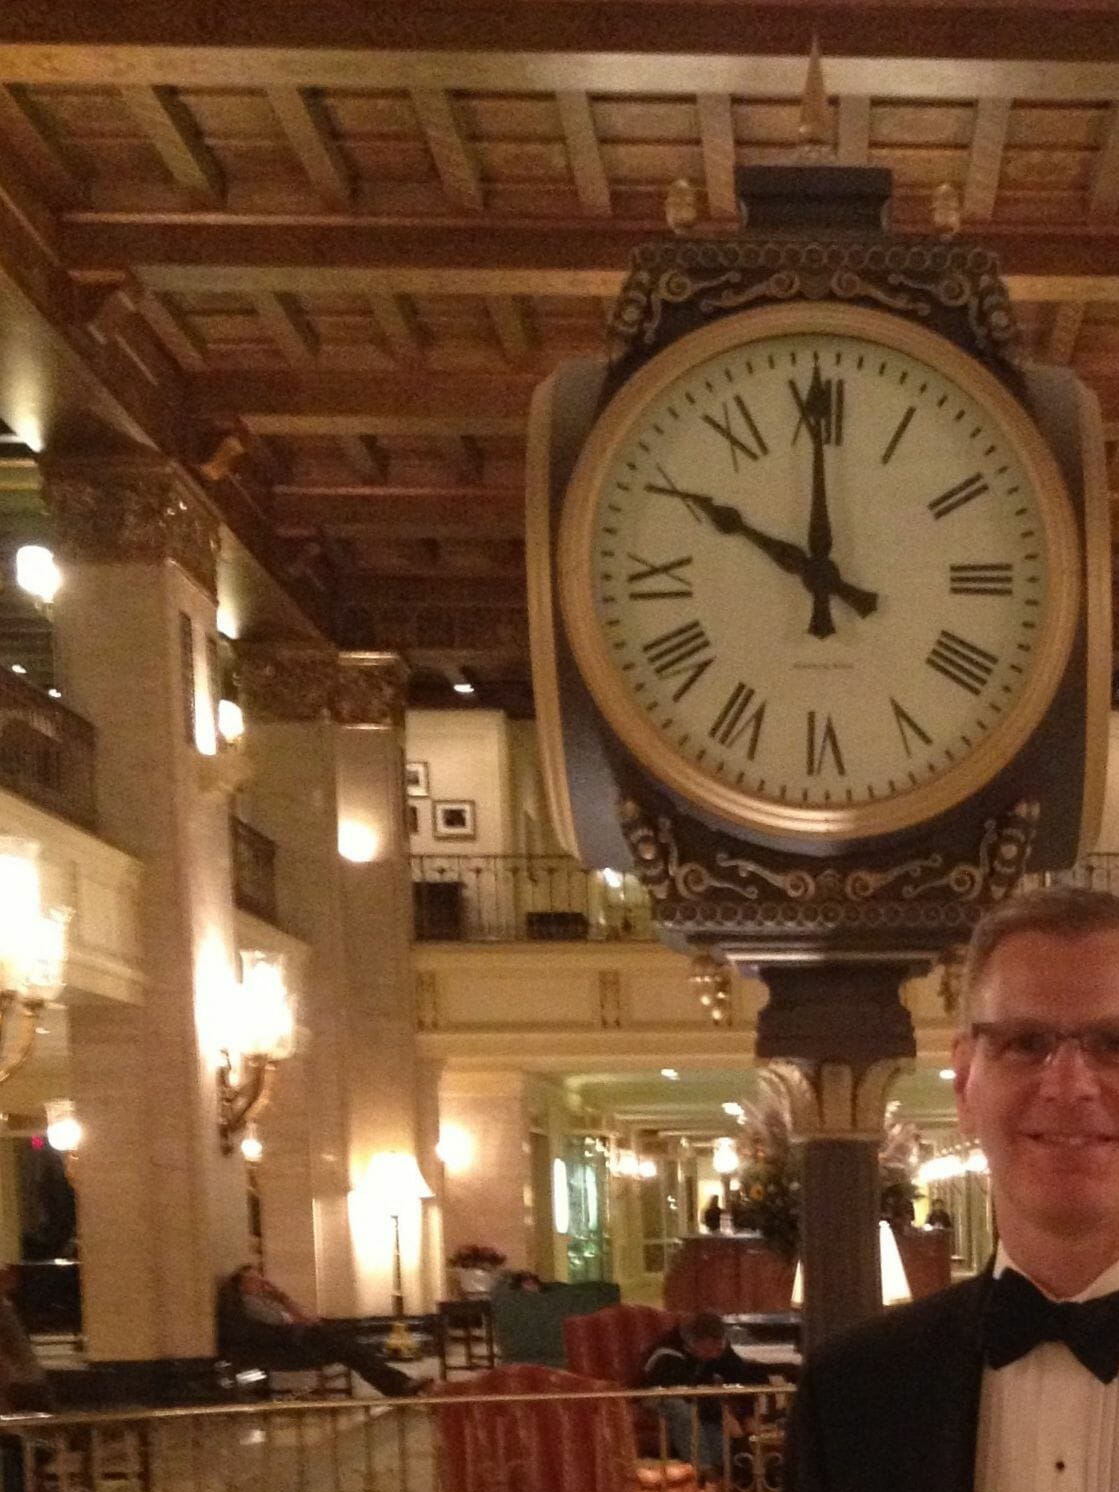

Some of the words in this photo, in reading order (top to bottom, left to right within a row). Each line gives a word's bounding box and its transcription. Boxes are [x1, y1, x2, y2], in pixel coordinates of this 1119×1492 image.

[702, 395, 768, 473] XI
[788, 379, 844, 446] XII
[882, 406, 916, 464] I
[645, 463, 713, 523] X
[927, 471, 989, 520] II
[626, 553, 693, 600] IX
[950, 563, 1013, 595] III
[643, 619, 717, 703] VIII
[925, 629, 999, 696] IIII
[708, 682, 766, 761] VII
[806, 711, 845, 777] VI
[890, 697, 933, 756] V
